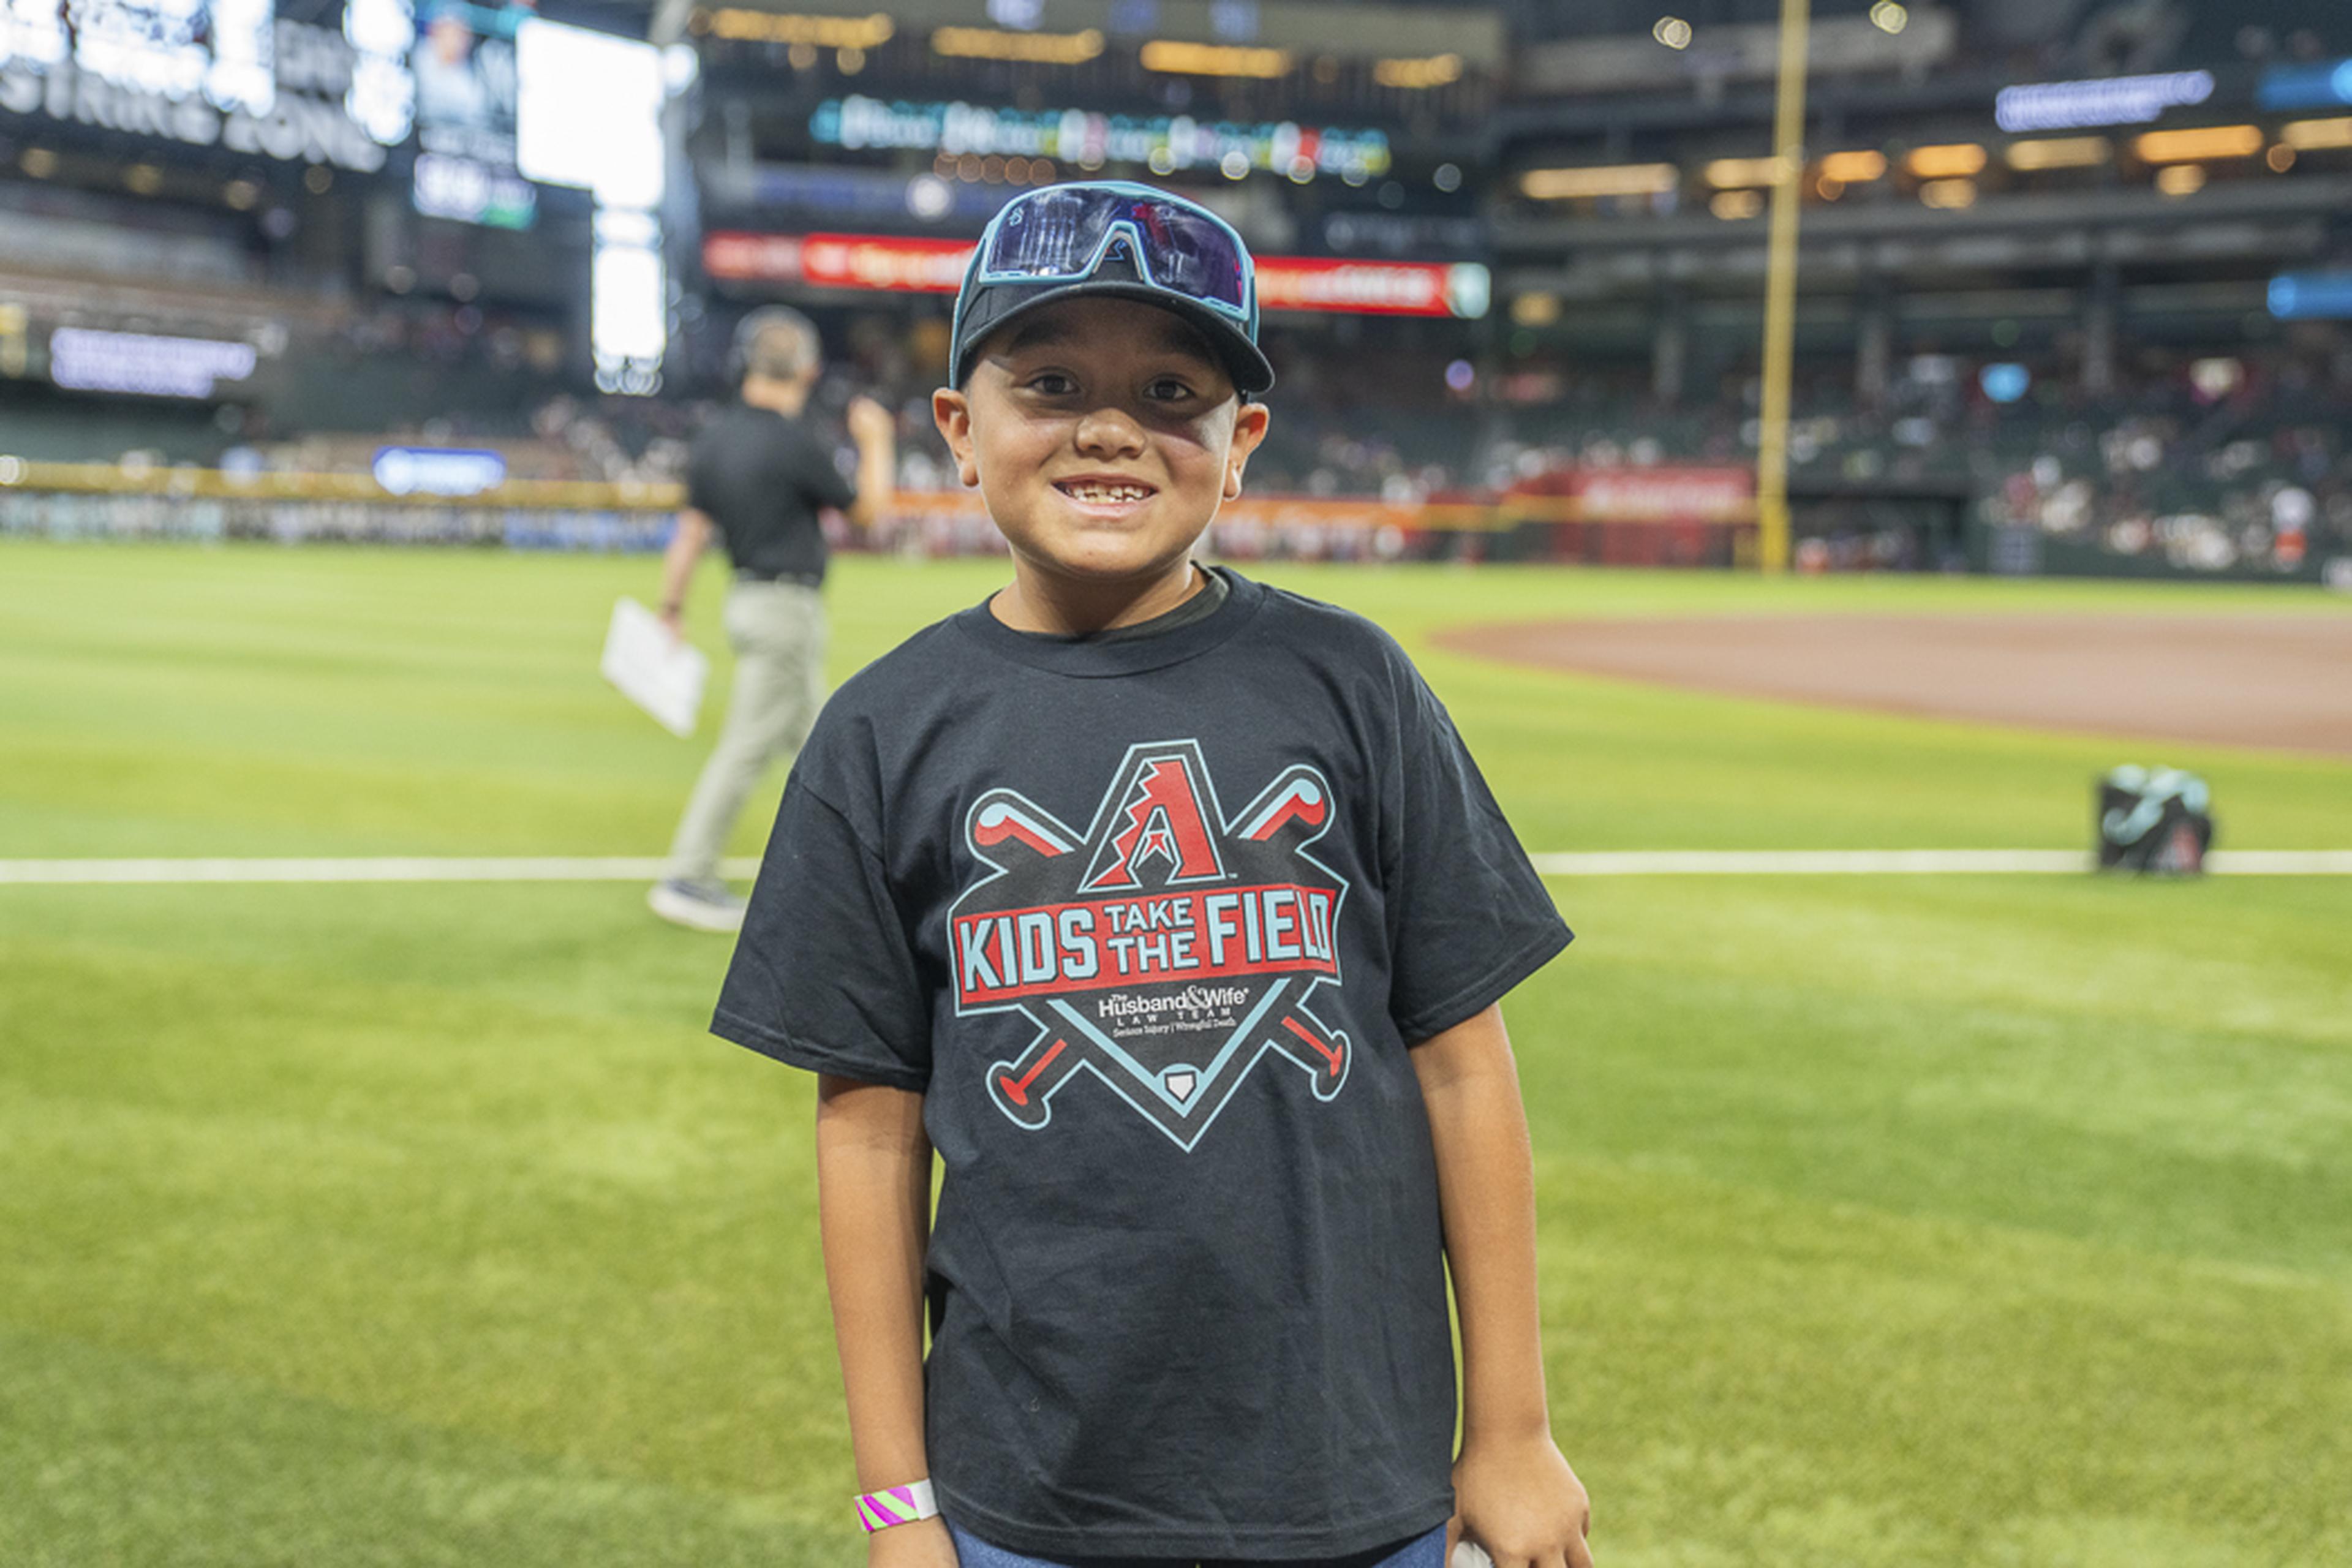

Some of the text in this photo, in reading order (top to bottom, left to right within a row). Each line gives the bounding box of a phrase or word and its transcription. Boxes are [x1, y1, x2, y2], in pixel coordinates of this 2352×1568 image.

[959, 889, 1332, 992] KIDS TAKE THE FIELD
[1117, 1007, 1231, 1027] LAW TEAM
